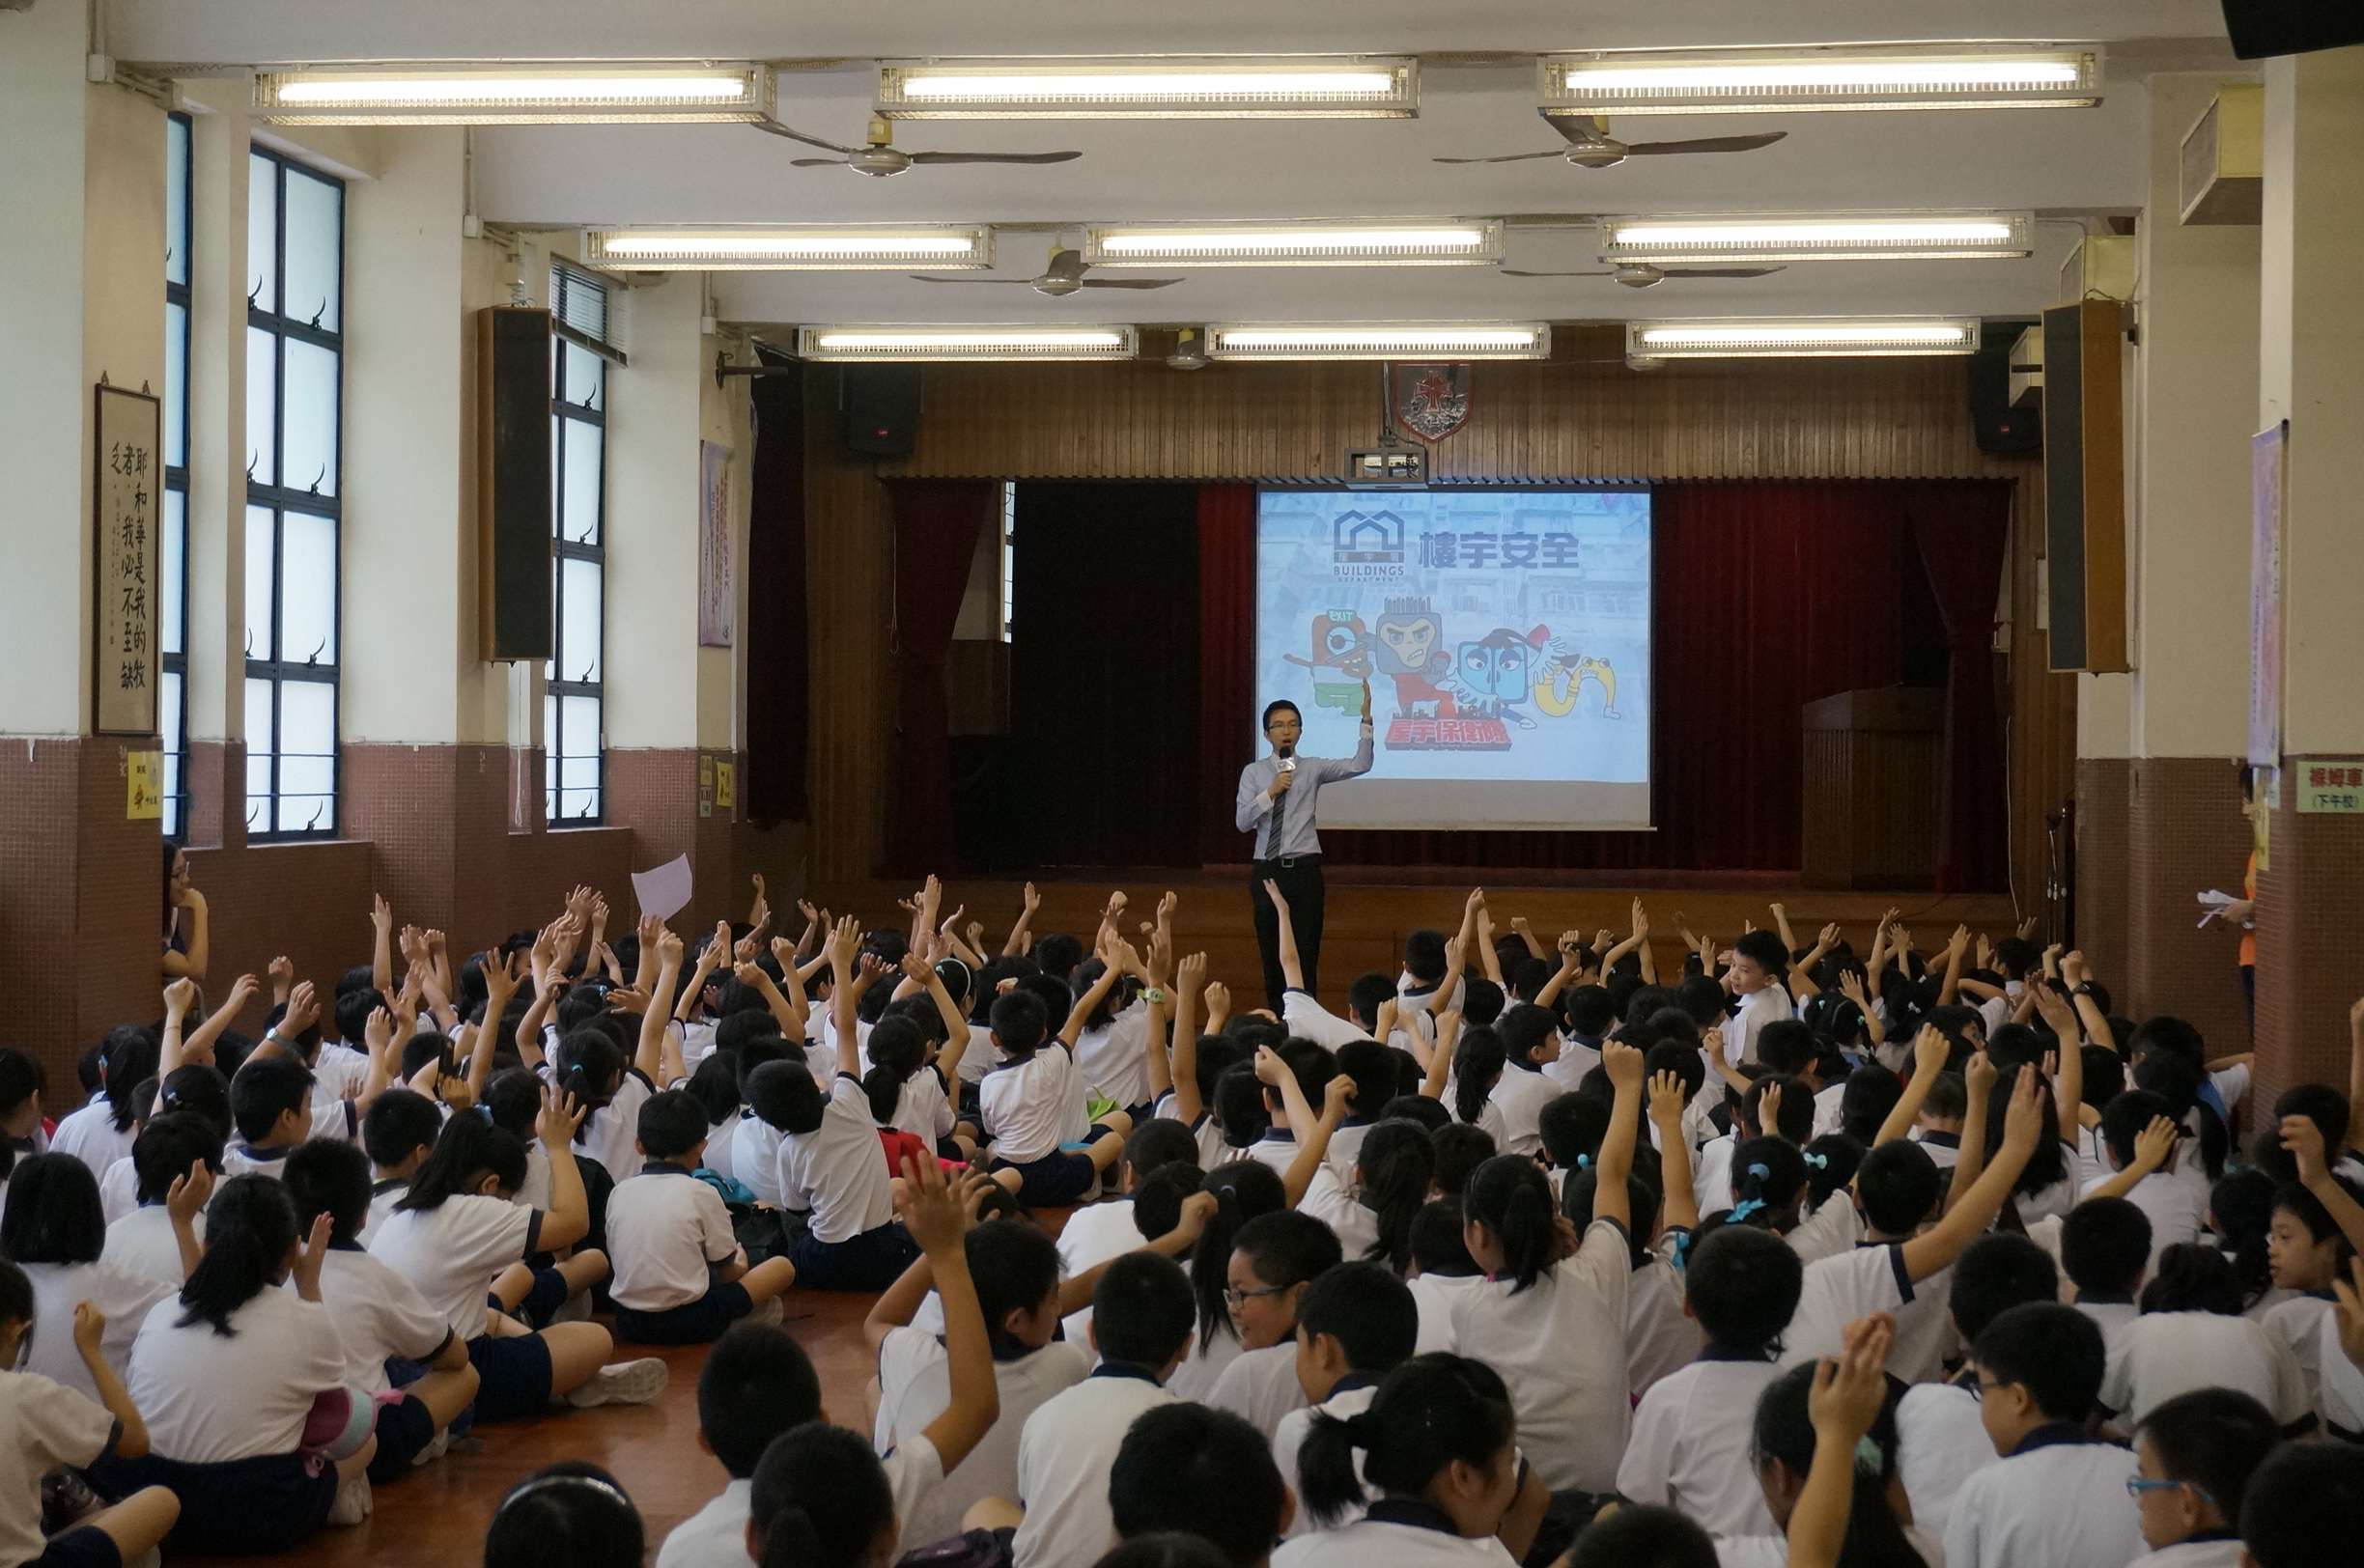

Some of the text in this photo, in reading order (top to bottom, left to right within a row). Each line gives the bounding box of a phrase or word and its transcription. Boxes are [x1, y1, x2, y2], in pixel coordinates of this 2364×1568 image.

[1420, 531, 1579, 568] 樓宇安全
[134, 447, 149, 689] 耶和華是我的牧
[1334, 565, 1404, 575] BUILDINGS
[1329, 610, 1354, 622] EXIT
